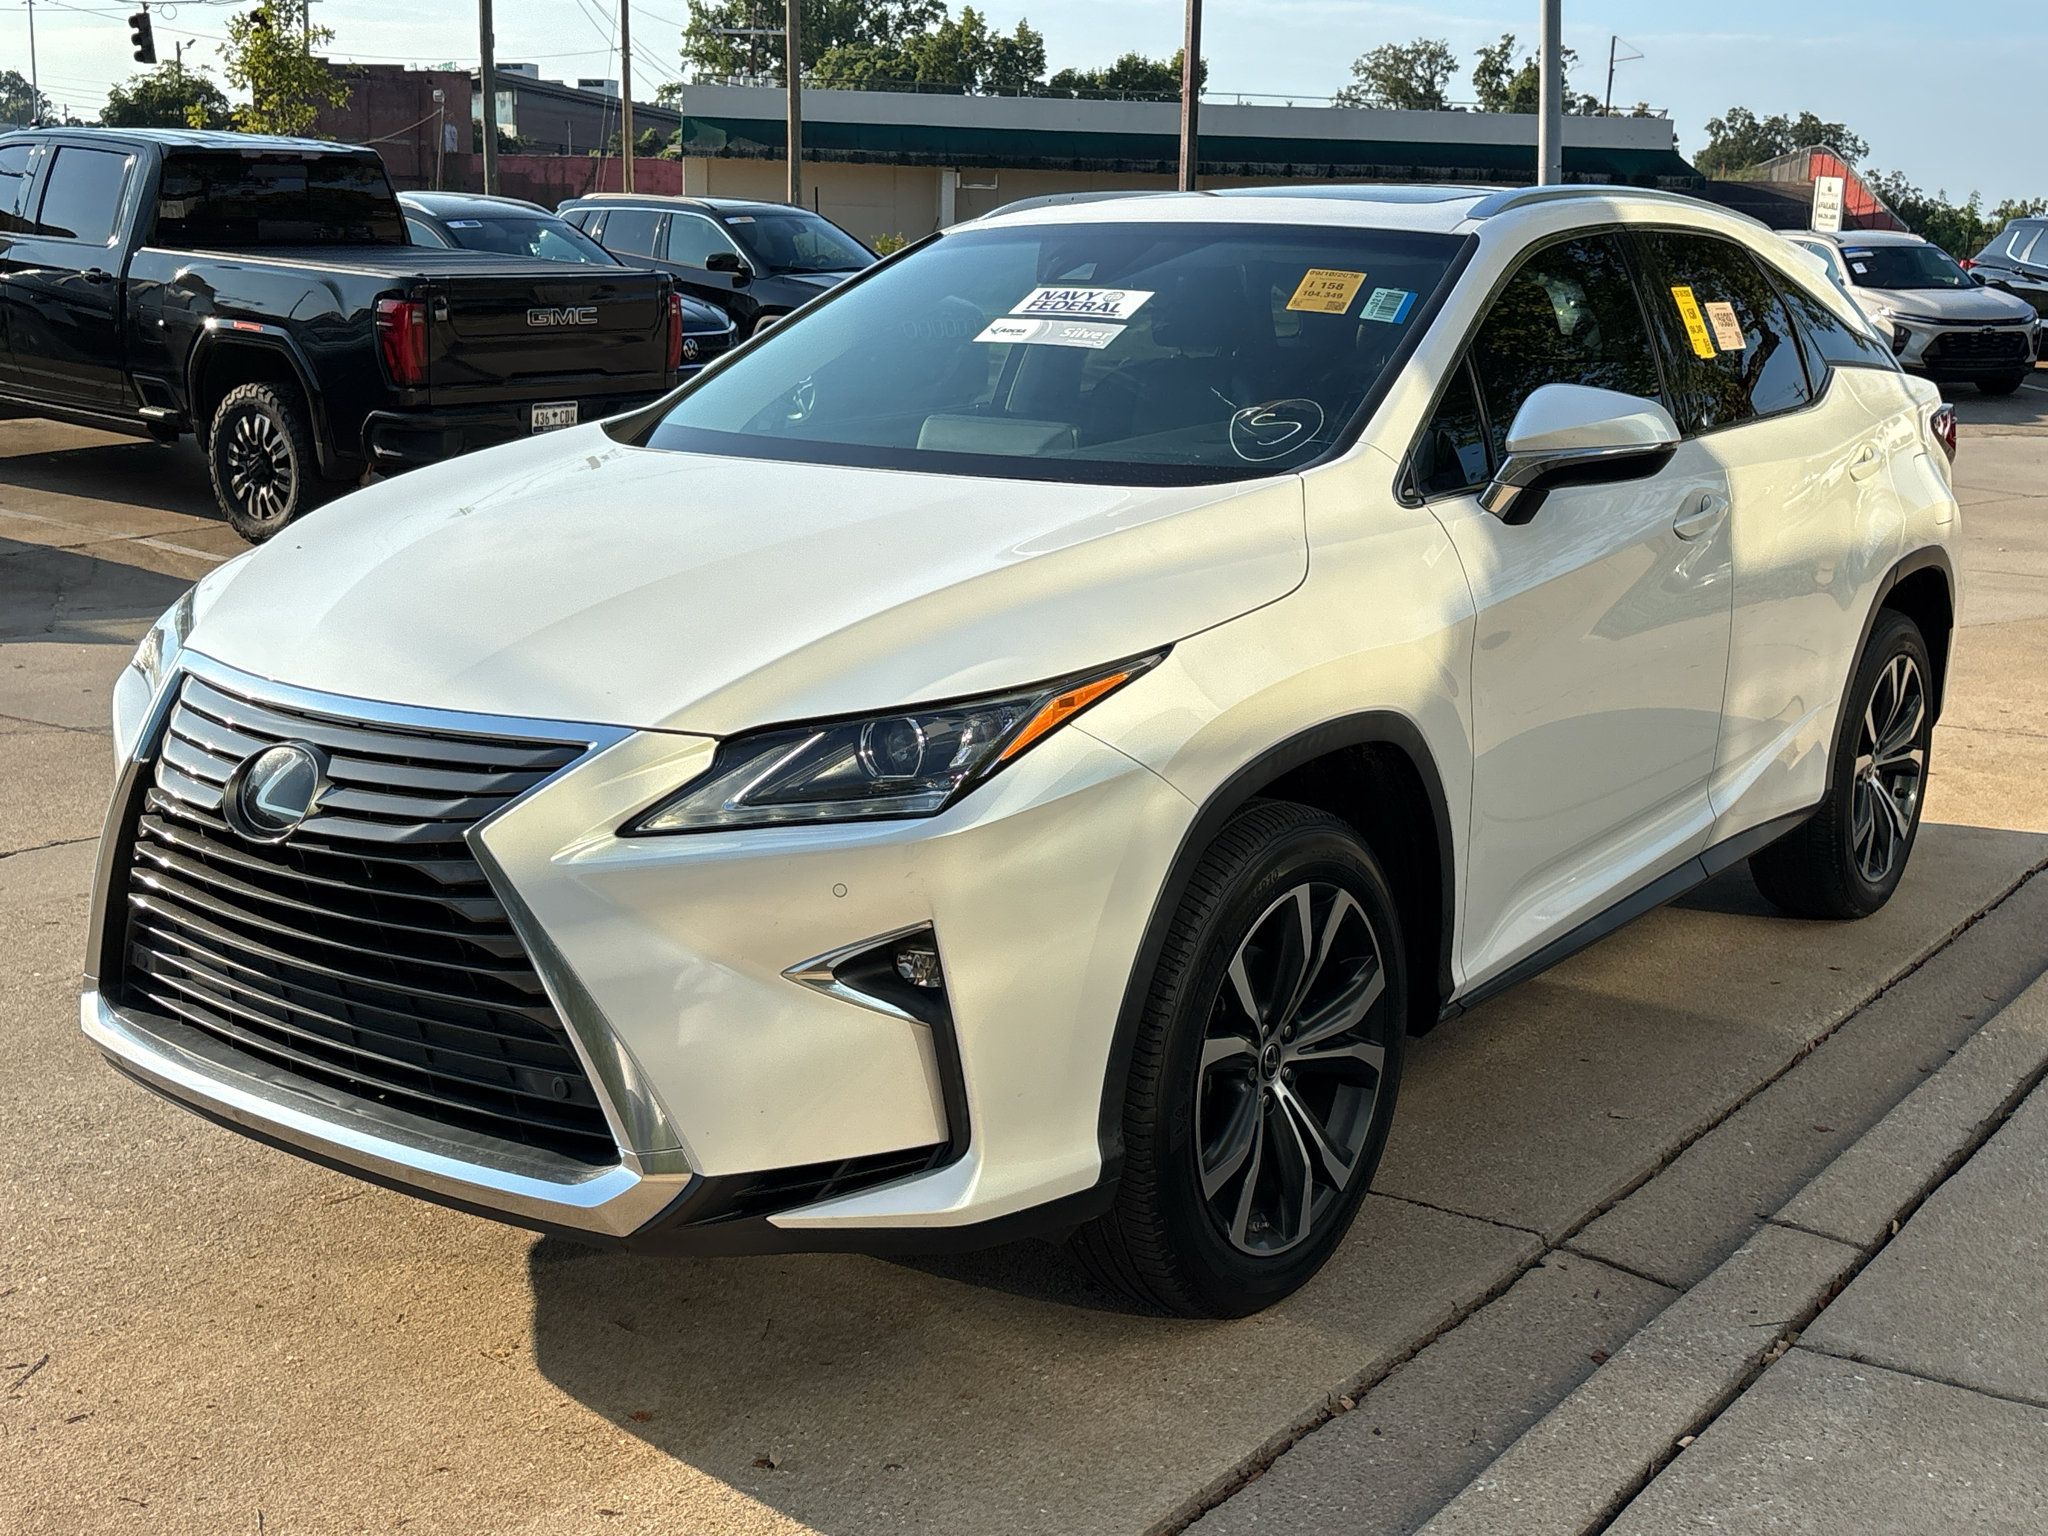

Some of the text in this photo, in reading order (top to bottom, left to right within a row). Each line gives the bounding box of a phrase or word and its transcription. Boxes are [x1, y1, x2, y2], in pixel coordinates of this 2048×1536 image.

[1321, 282, 1345, 290] 158
[1037, 290, 1103, 301] NAVY
[1026, 300, 1121, 313] FEDERAL
[527, 307, 598, 327] GMC
[1063, 327, 1113, 340] Silver
